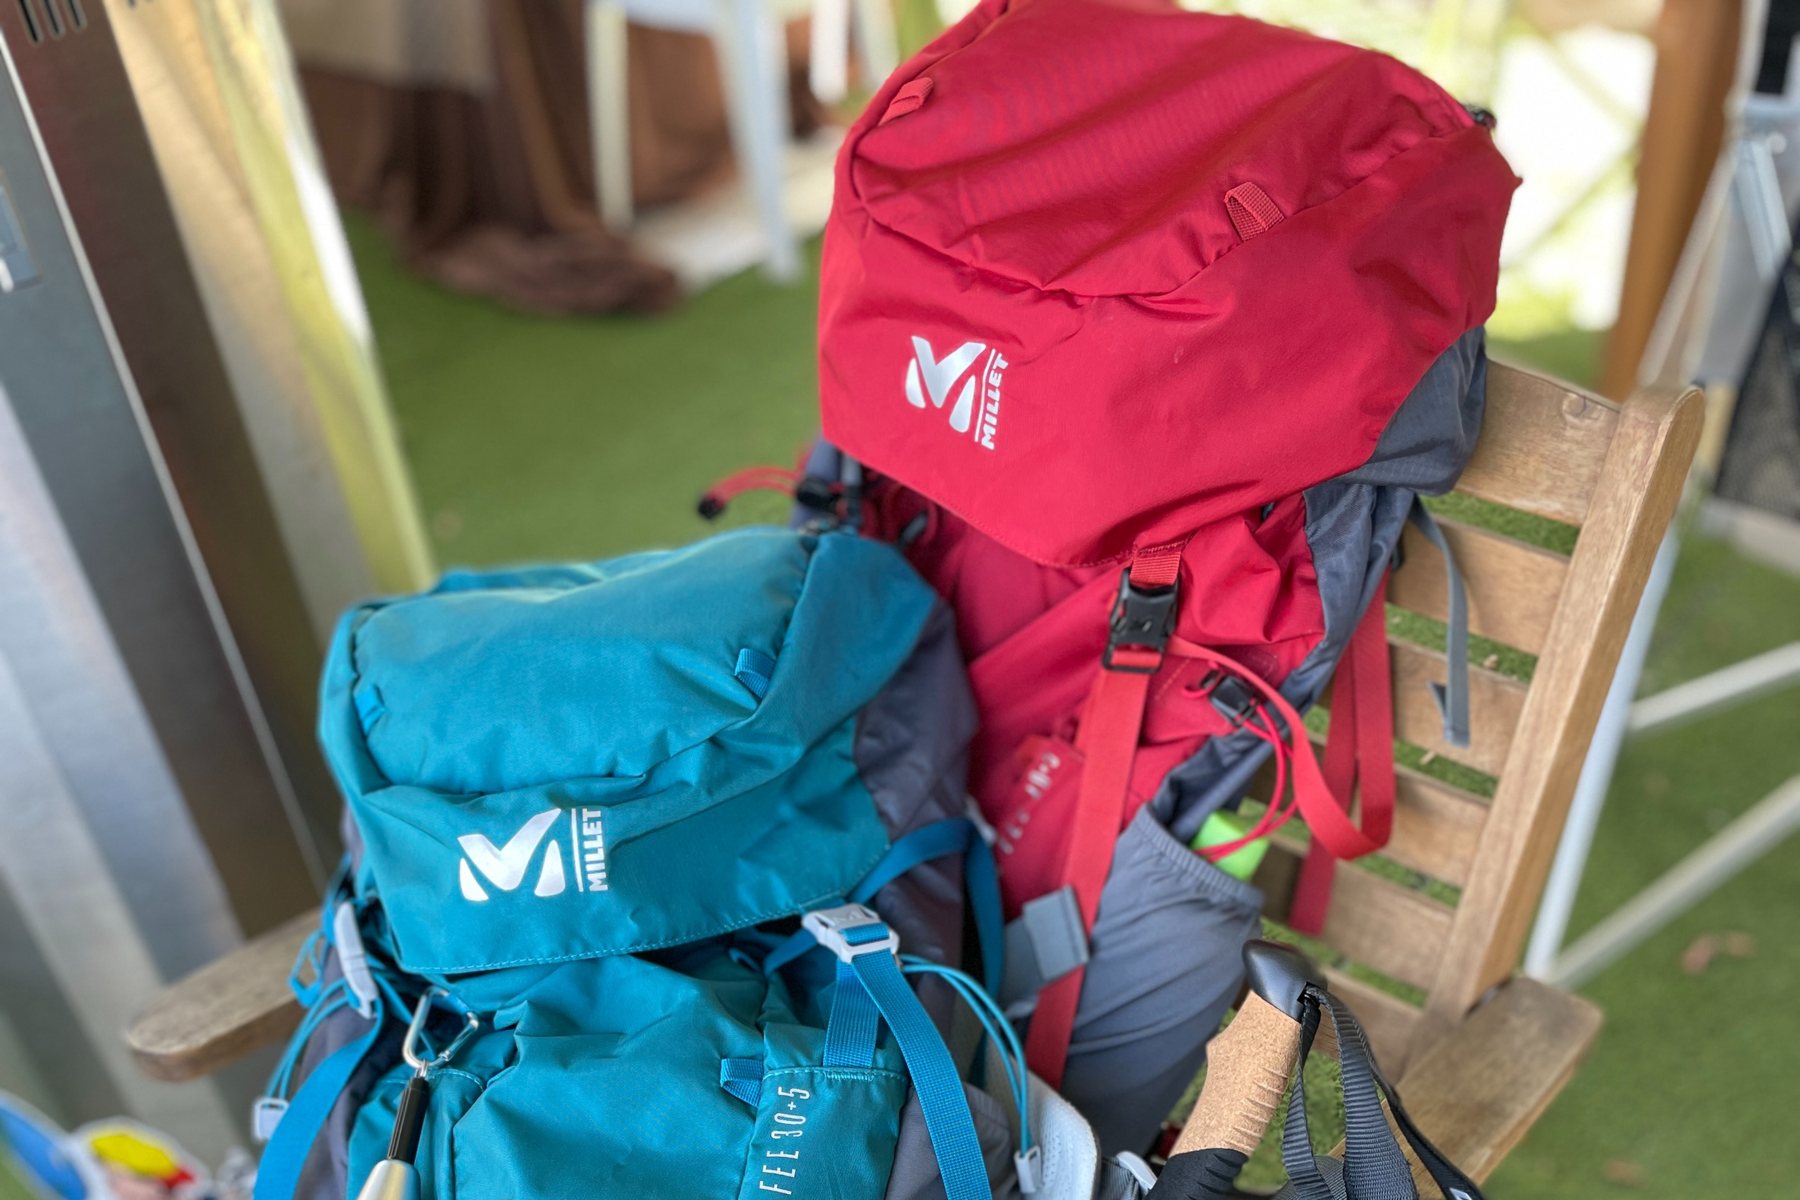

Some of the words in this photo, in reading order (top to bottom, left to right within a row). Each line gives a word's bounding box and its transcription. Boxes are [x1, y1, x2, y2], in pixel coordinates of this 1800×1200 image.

[981, 352, 1009, 451] MILLET
[582, 808, 608, 892] MILLET
[771, 1086, 810, 1140] 30+5
[759, 1150, 800, 1195] FEE
